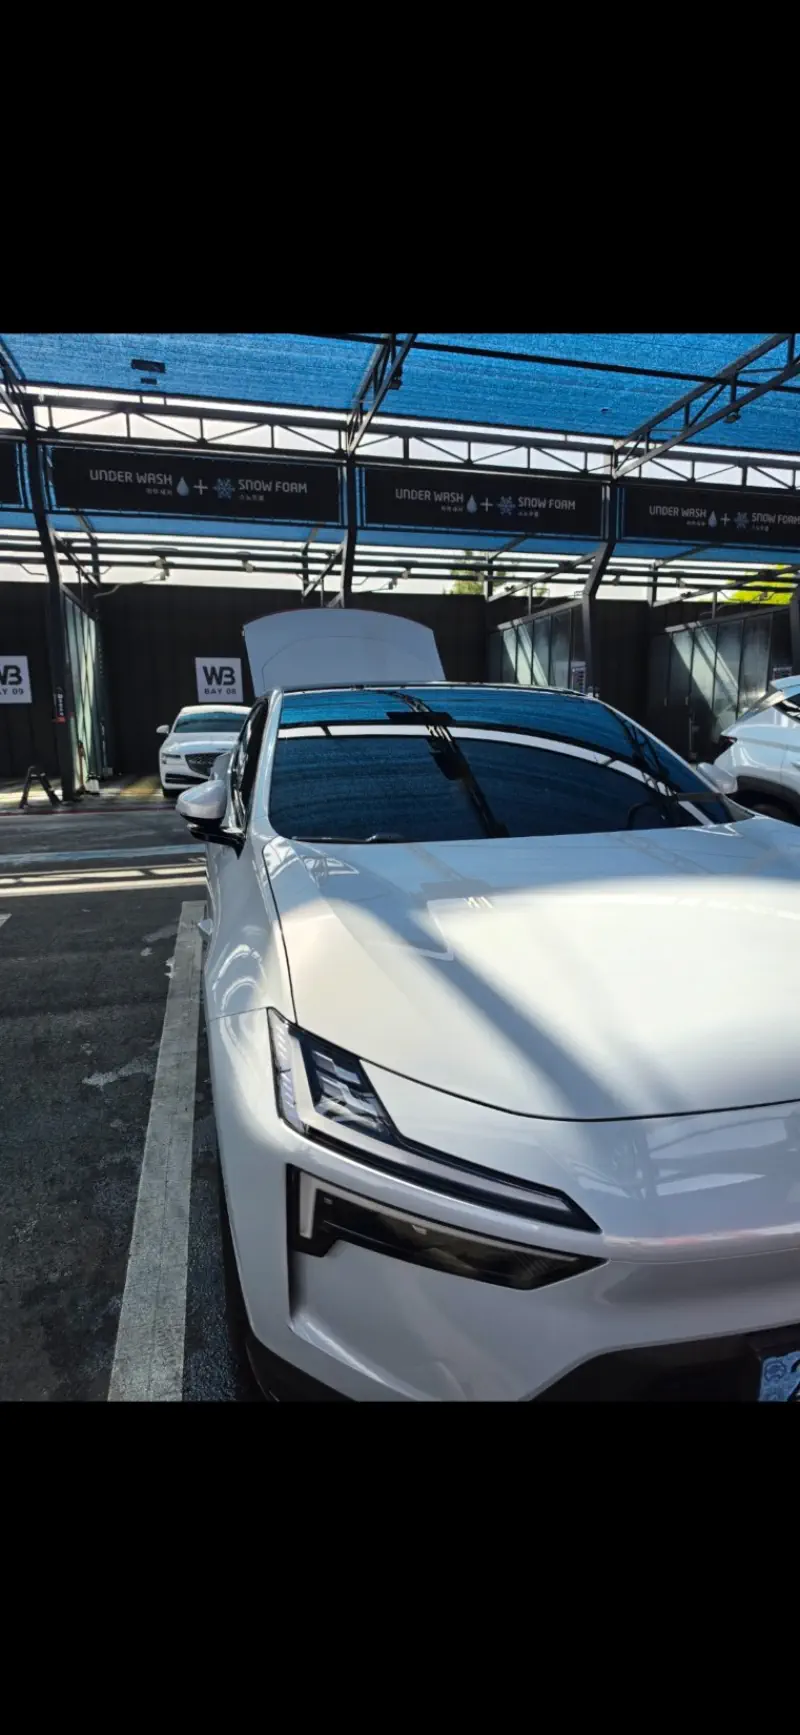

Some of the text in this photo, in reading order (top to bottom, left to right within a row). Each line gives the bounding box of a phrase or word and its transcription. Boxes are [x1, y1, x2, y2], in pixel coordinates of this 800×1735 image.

[89, 469, 173, 487] UNDER WASH
[238, 478, 308, 494] SNOW FOAM
[395, 488, 464, 504] UNDER WASH
[518, 496, 576, 511] SNOW FOAM
[649, 505, 707, 518] UNDER WASH
[751, 513, 776, 523] SNOW
[202, 665, 236, 686] WB
